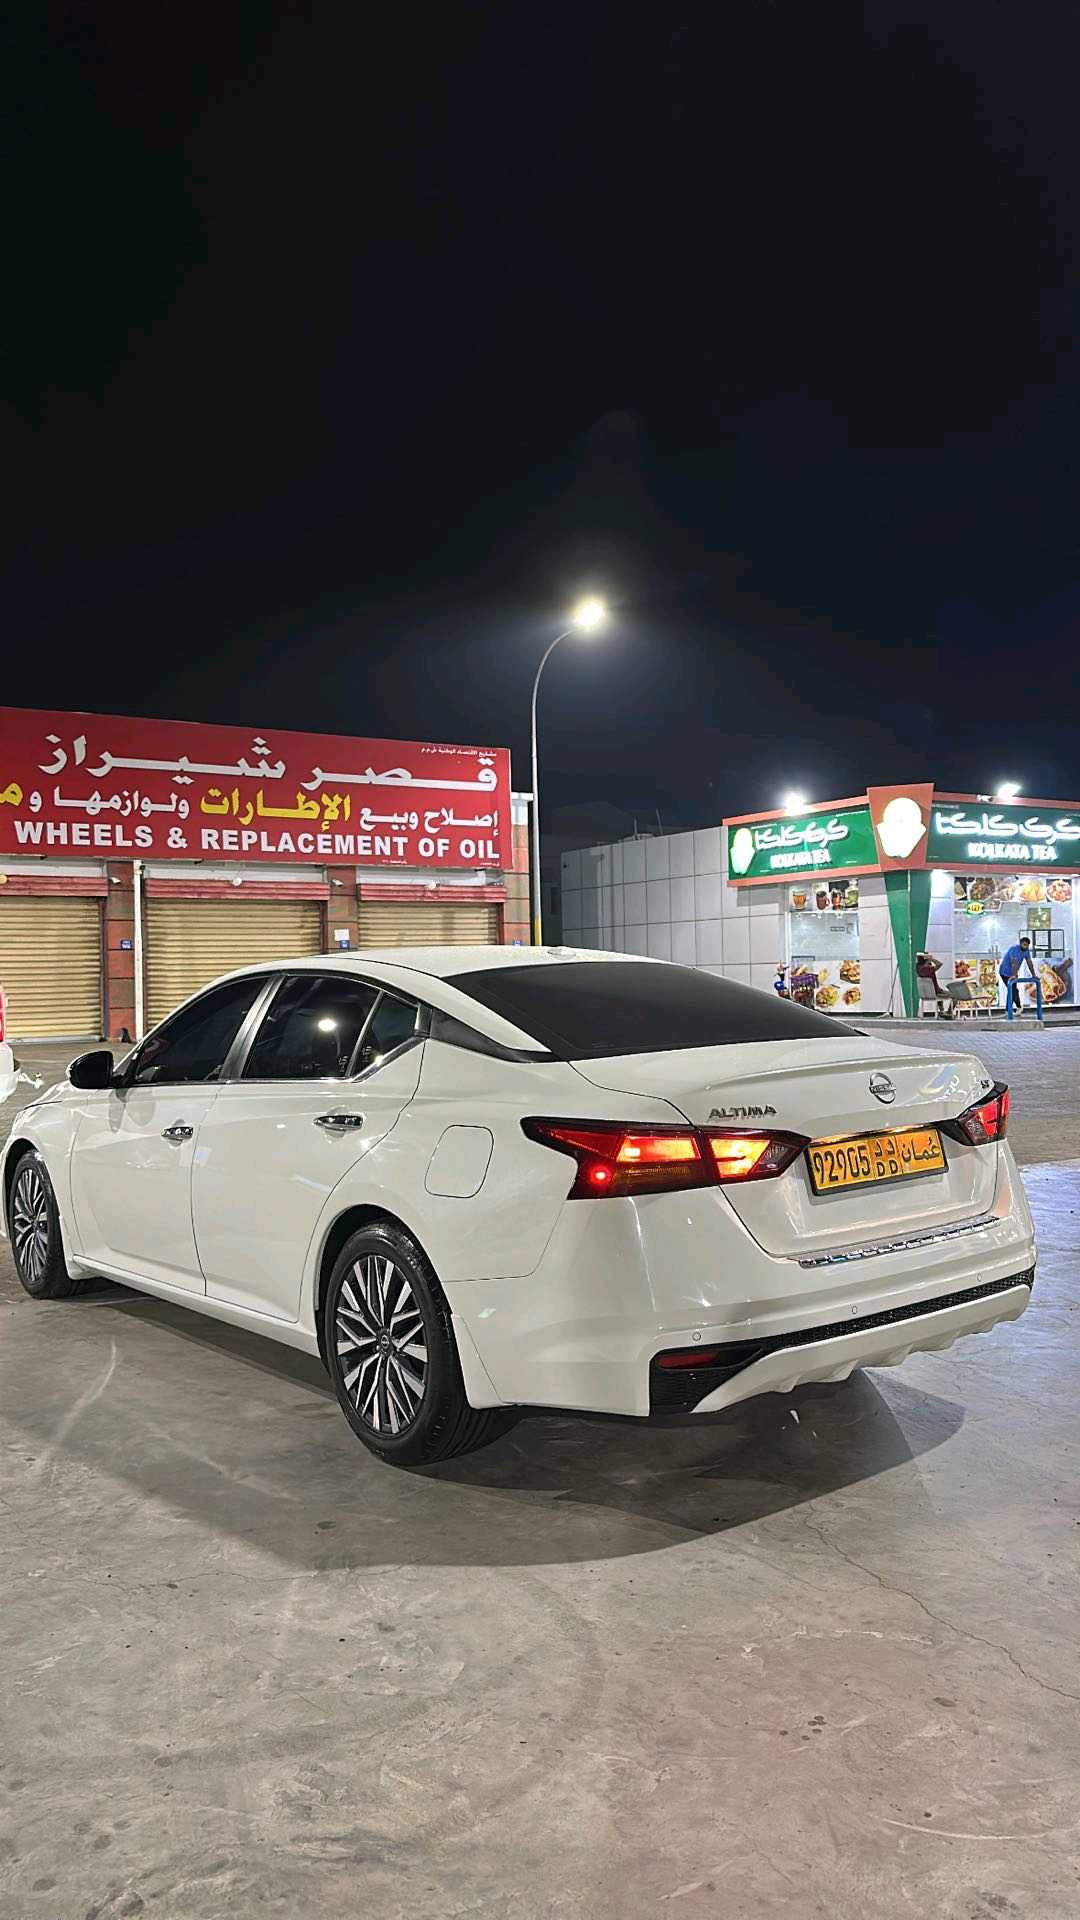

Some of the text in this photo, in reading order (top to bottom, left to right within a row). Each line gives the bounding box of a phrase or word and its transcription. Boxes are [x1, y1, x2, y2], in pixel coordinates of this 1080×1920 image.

[38, 734, 498, 791] قصر شيراز
[53, 786, 190, 819] ولوازمها
[200, 788, 351, 832] الإطارات
[359, 807, 419, 832] وبيع
[14, 821, 500, 859] WHEELS & REPLACEMENT OF OIL
[423, 808, 499, 837] إصلاح
[709, 1105, 777, 1119] ALTIMA
[813, 1144, 871, 1184] 92905
